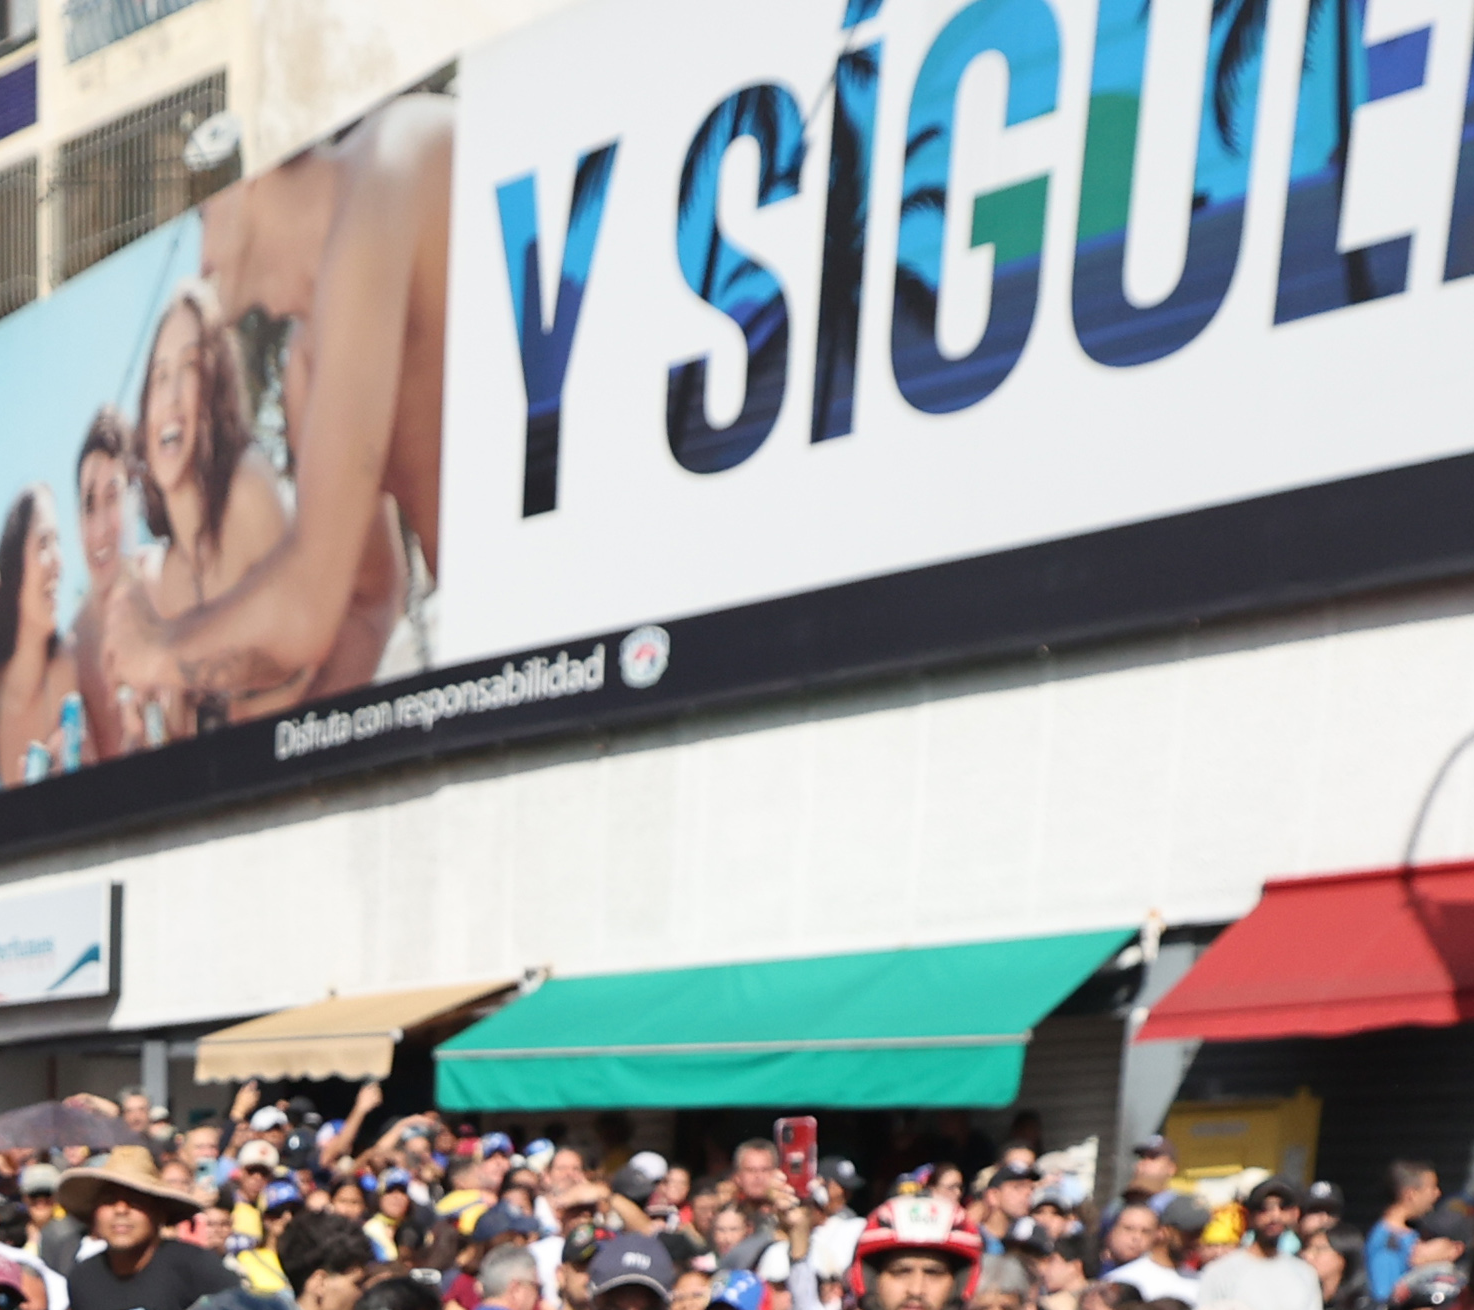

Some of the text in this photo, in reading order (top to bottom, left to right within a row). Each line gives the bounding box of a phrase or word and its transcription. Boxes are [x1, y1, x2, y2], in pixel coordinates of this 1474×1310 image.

[495, 135, 622, 520] Y
[273, 643, 606, 761] Disfruta con responsabilidad
